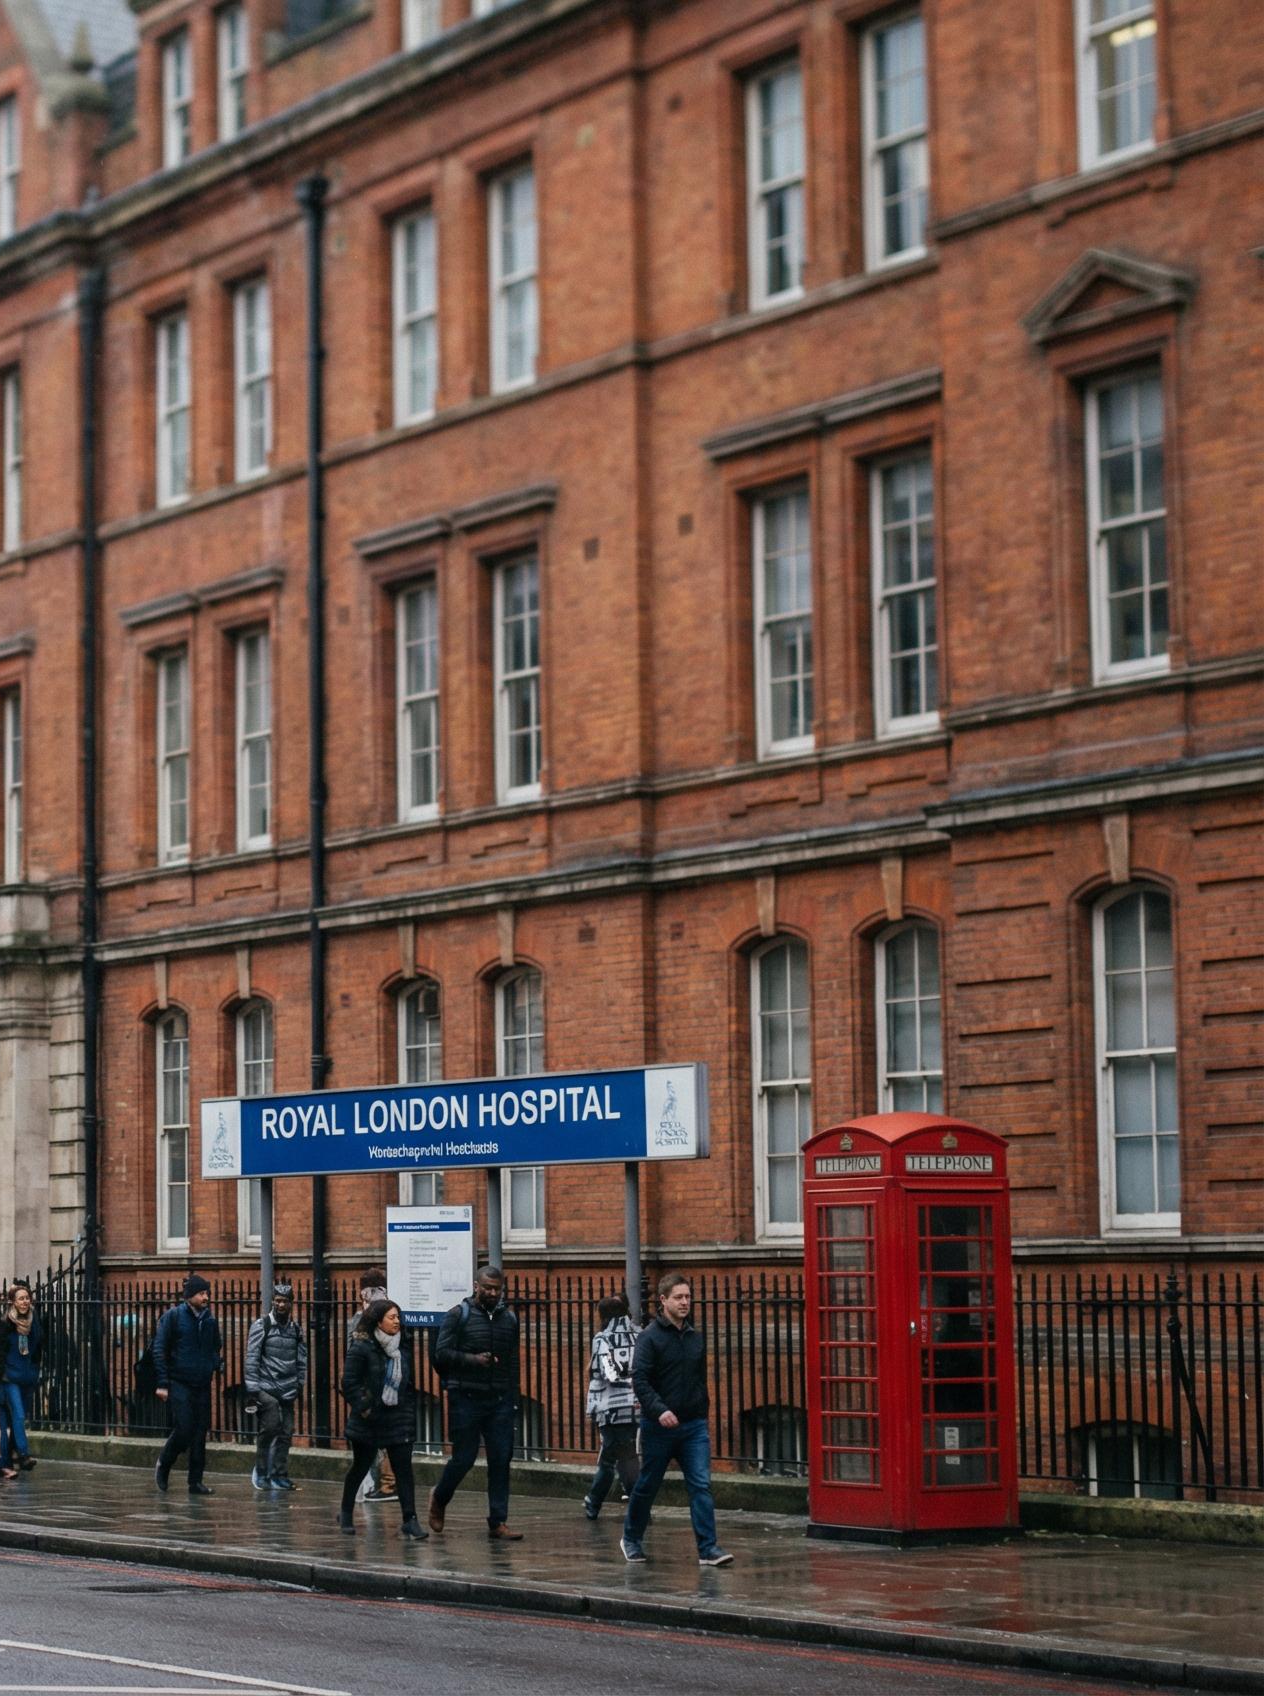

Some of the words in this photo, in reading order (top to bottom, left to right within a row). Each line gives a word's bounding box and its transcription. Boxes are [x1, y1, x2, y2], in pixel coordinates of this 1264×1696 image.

[261, 1104, 345, 1140] ROYAL
[354, 1094, 468, 1135] LONDON
[478, 1084, 621, 1128] HOSPITAL
[910, 1156, 992, 1171] TELEPHONE
